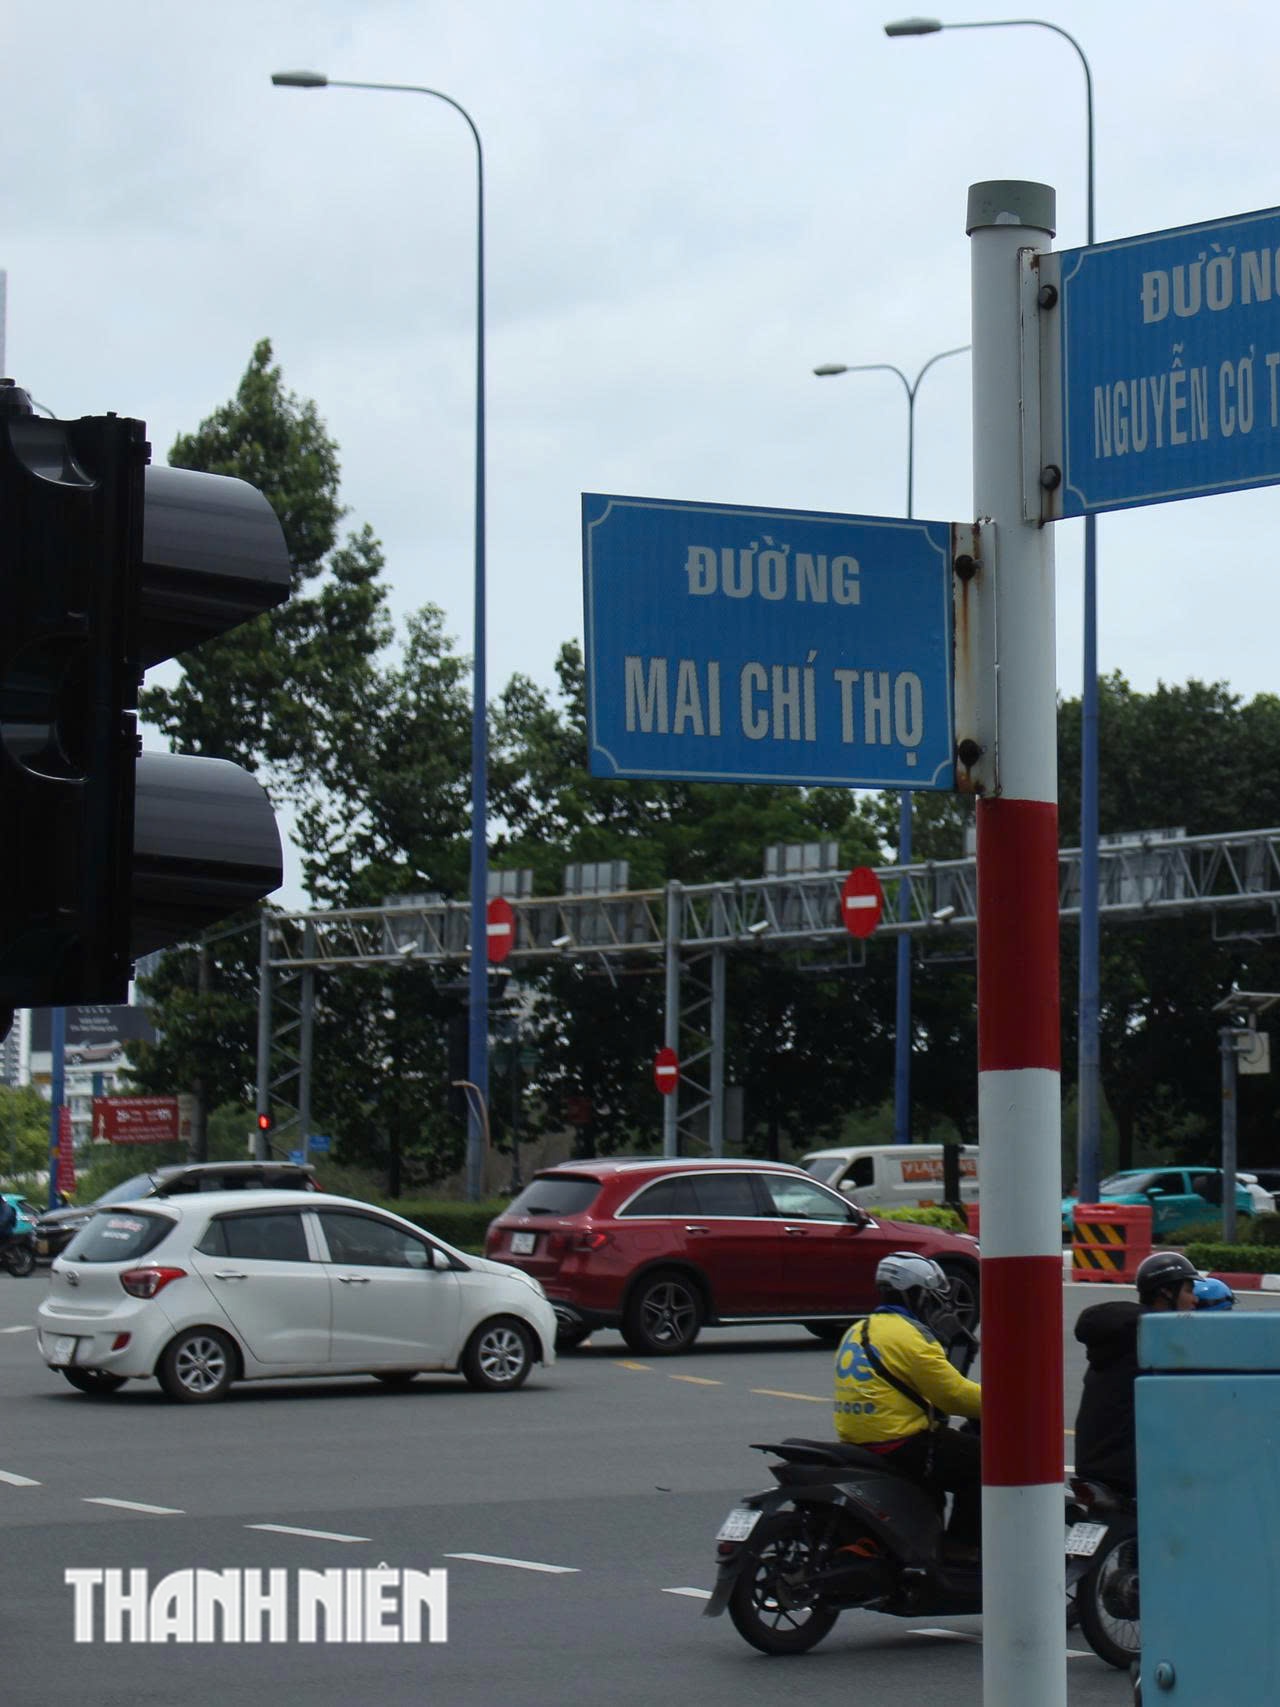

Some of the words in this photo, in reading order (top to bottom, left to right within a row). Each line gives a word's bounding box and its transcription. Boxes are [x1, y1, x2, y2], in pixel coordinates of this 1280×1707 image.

[1093, 341, 1209, 460] NGUYỄN
[1218, 344, 1256, 438] CƠ
[684, 535, 862, 606] ĐƯỜNG
[623, 654, 722, 737] MAI
[739, 649, 819, 742] CHÍ
[833, 667, 925, 767] THỌ
